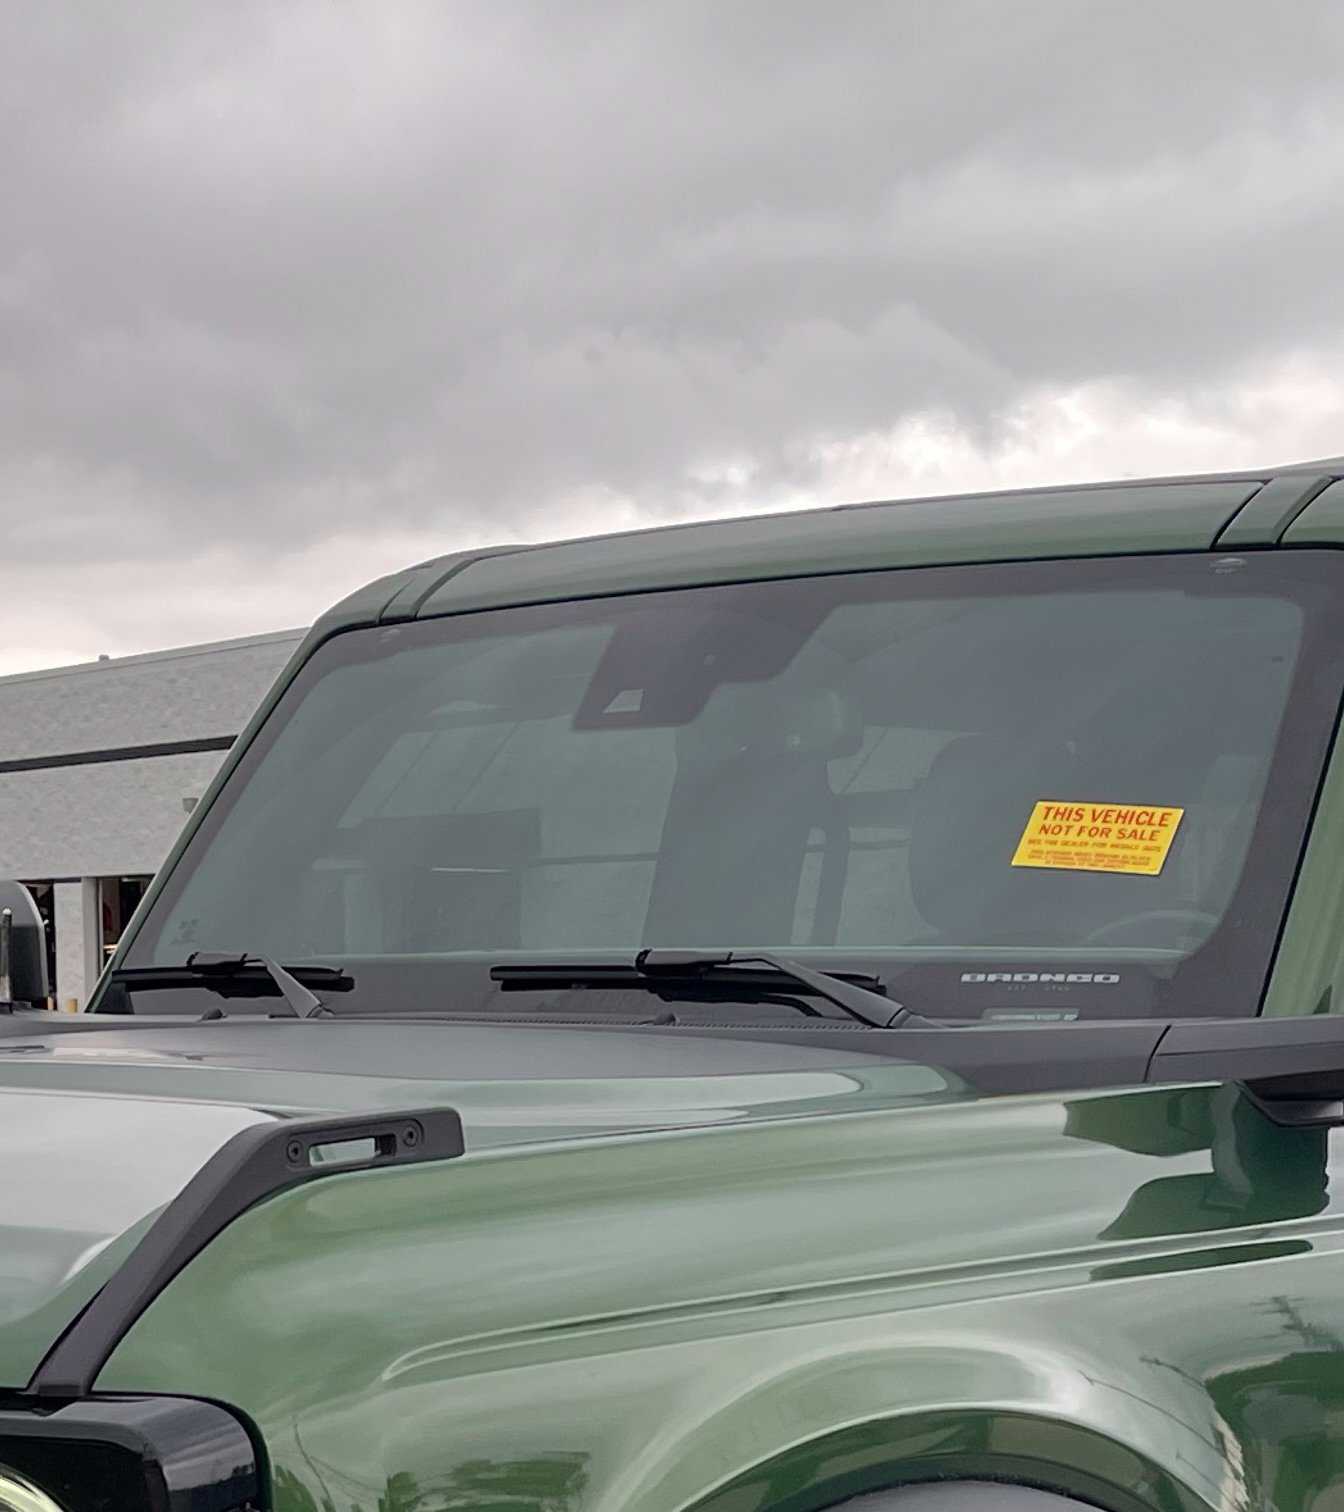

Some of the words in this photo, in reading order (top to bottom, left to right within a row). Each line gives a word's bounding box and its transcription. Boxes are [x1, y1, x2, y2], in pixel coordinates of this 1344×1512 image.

[1042, 806, 1085, 822] THIS
[1091, 808, 1173, 828] VEHICLE
[1038, 823, 1074, 836] NOT
[1076, 825, 1112, 838] FOR
[1116, 828, 1161, 842] SALE
[961, 973, 1120, 983] BRONCO
